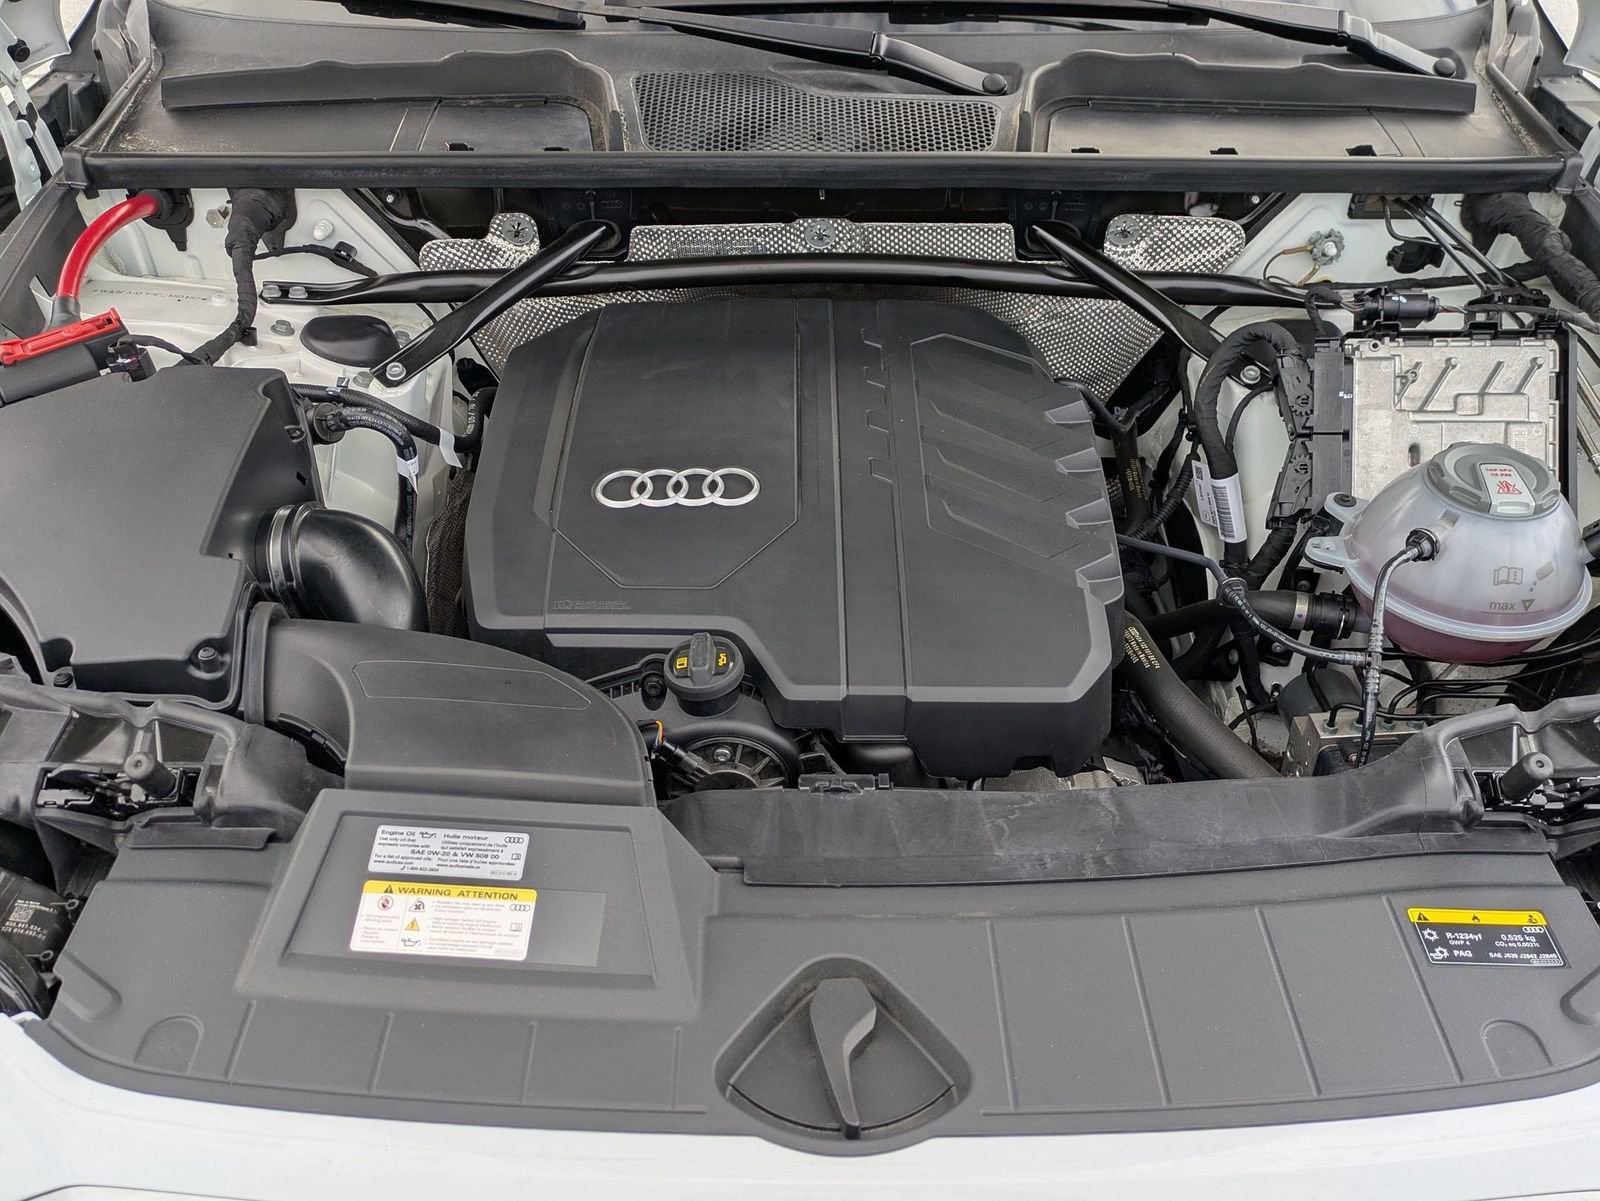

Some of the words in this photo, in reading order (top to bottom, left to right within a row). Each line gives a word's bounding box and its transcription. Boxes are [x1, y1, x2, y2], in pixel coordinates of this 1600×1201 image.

[1489, 601, 1516, 610] max
[398, 886, 452, 897] WARNING
[457, 888, 519, 900] ATTENTION
[1445, 932, 1482, 941] R-1234yf
[1525, 934, 1536, 943] kg
[1453, 949, 1473, 958] PAG
